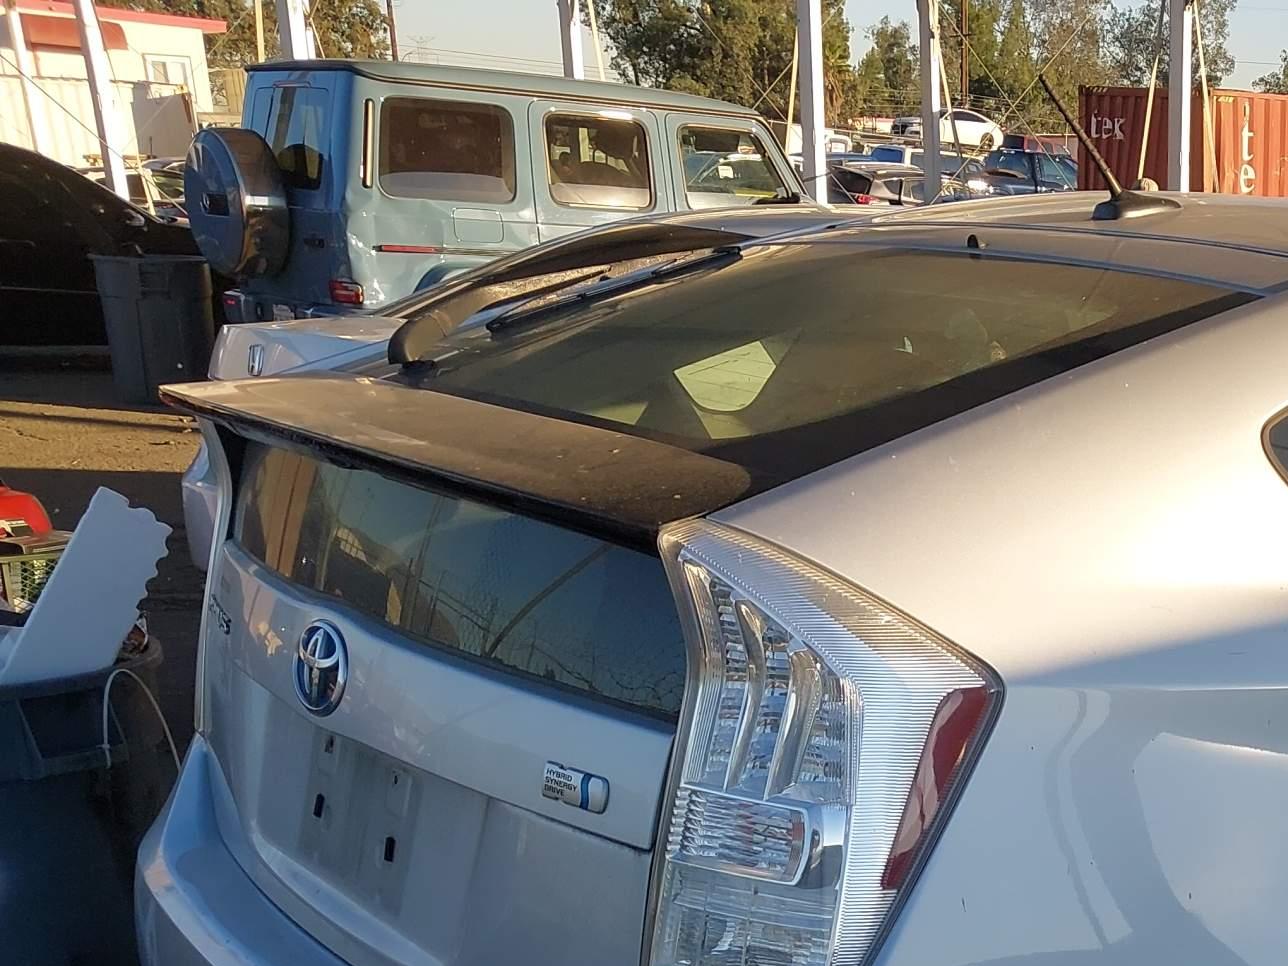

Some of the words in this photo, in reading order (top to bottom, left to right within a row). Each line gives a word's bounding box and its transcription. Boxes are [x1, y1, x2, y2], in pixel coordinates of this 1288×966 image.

[546, 767, 573, 783] HYBRID
[544, 784, 564, 797] DRIVE
[545, 776, 577, 792] SYNERGY
